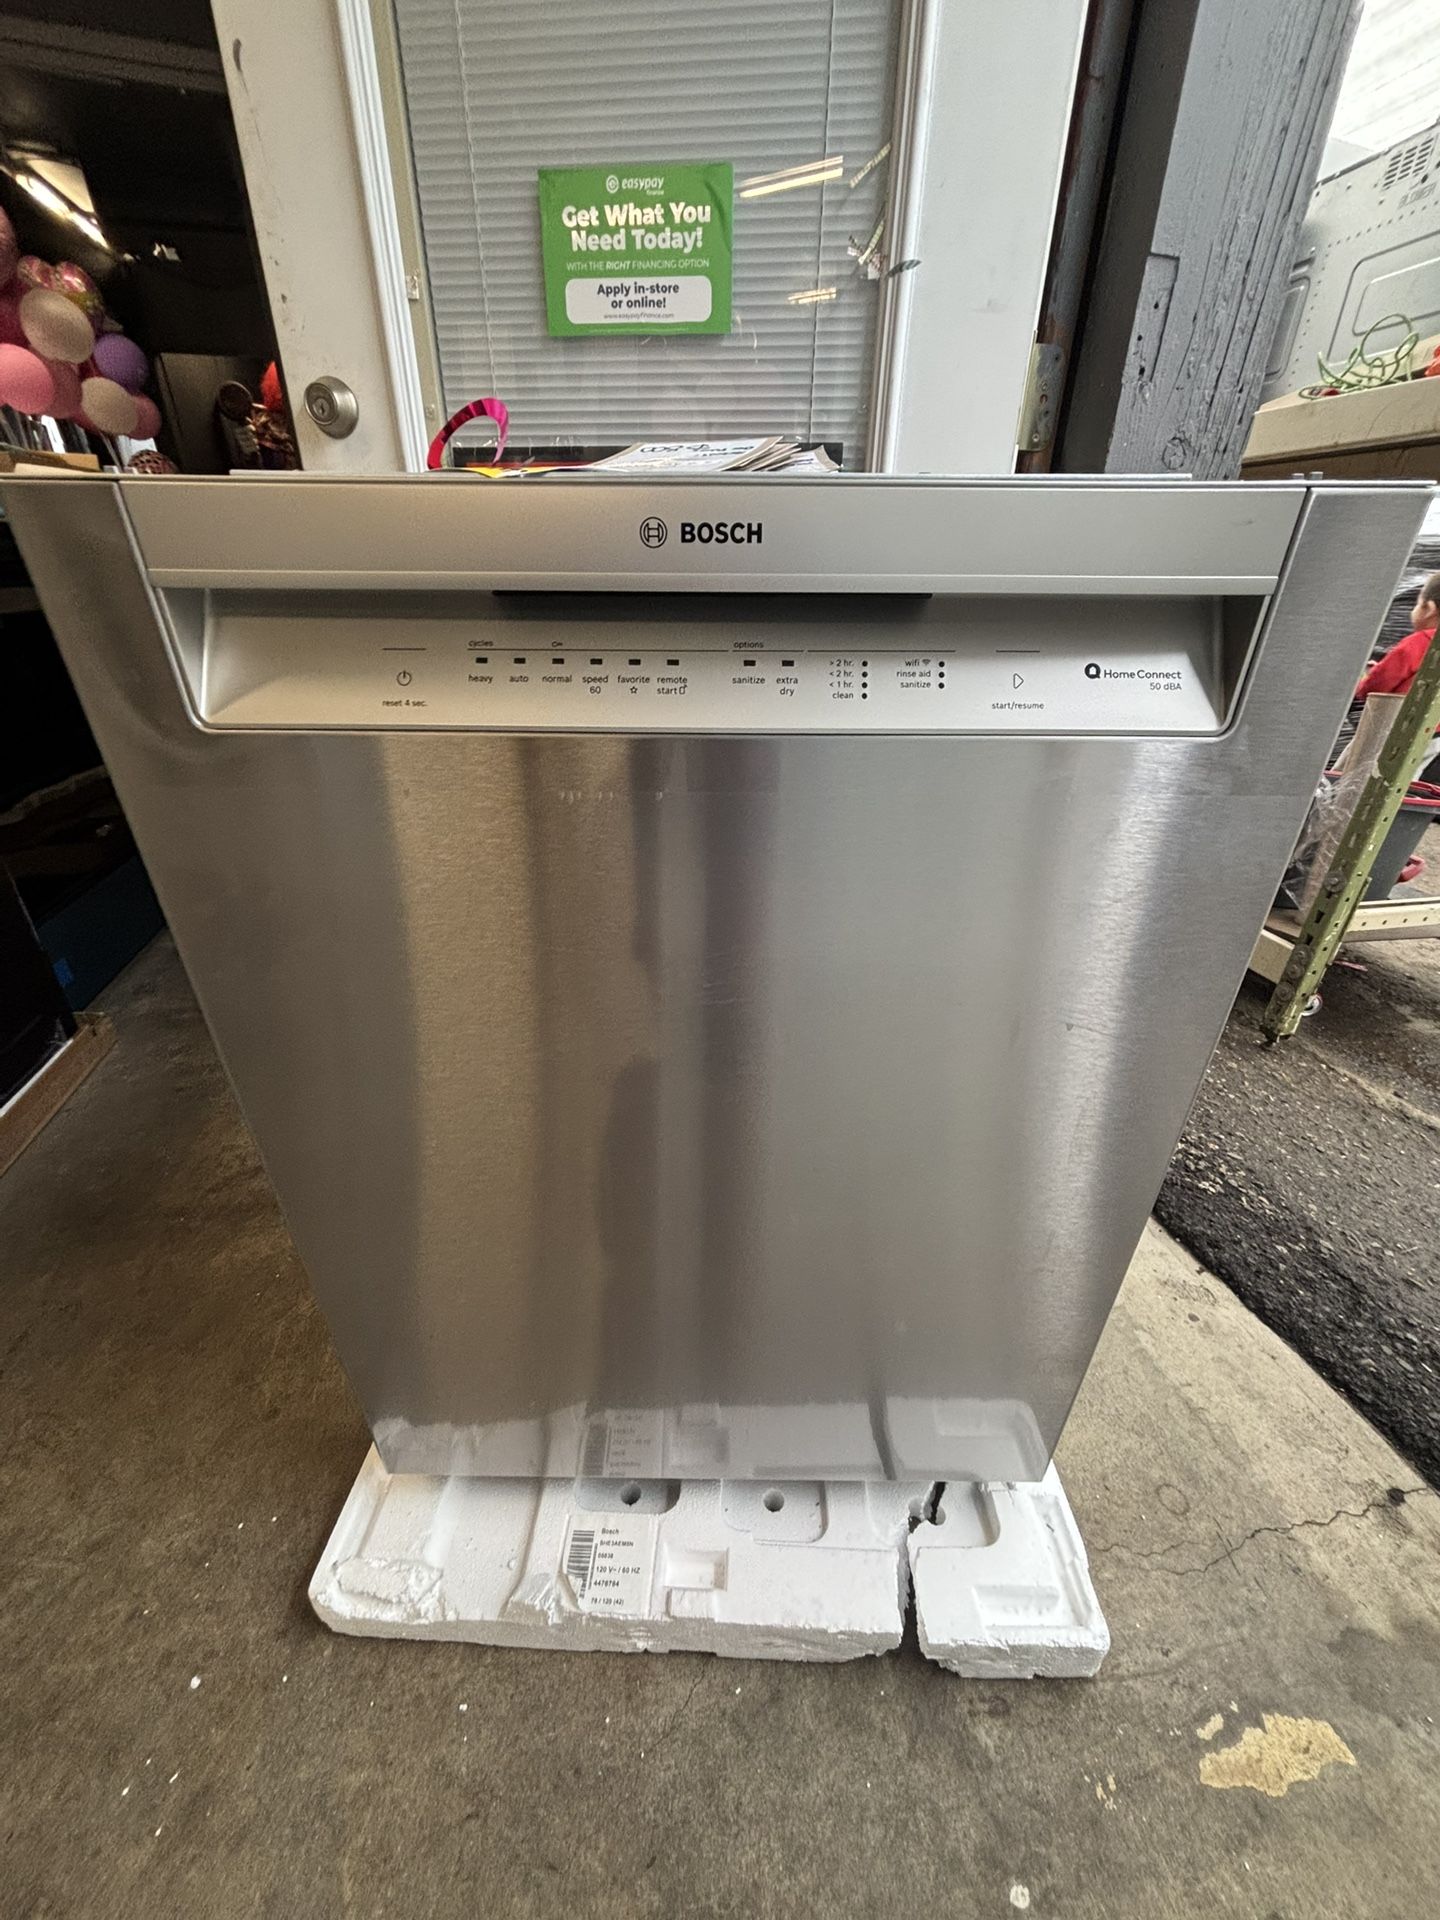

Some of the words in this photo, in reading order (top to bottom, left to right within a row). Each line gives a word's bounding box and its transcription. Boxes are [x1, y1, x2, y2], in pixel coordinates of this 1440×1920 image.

[622, 177, 665, 191] easypay
[562, 205, 599, 228] Get
[604, 202, 665, 227] What
[669, 201, 711, 225] You
[571, 228, 626, 252] Need
[631, 227, 703, 254] Today!
[566, 261, 587, 271] WITH
[589, 261, 604, 271] THE
[606, 260, 631, 271] RIGHT
[632, 259, 677, 270] FINANCING
[678, 258, 710, 269] OPTION
[597, 283, 631, 298] Apply
[634, 281, 679, 294] in-store
[611, 299, 622, 309] or
[626, 296, 666, 309] online!
[681, 522, 763, 544] BOSCH
[468, 639, 494, 647] cycles
[733, 641, 764, 649] options
[836, 659, 842, 667] 2
[843, 659, 854, 667] hr.
[904, 659, 920, 667] wifi
[836, 670, 842, 678] 2
[843, 670, 854, 678] hr.
[896, 670, 917, 678] rinse
[918, 670, 931, 678] aid
[1103, 669, 1136, 679] Home
[1136, 669, 1182, 679] Connect
[468, 674, 493, 684] heavy
[509, 675, 529, 683] auto
[542, 675, 572, 683] normal
[582, 675, 609, 686] speed
[617, 675, 650, 684] favorite
[656, 676, 688, 684] remote
[732, 676, 765, 684] sanitize
[776, 676, 799, 684] extra
[843, 681, 854, 689] hr.
[900, 681, 931, 689] sanitize
[1150, 682, 1161, 690] 50
[1163, 682, 1182, 691] dBA
[589, 686, 601, 694] 60
[656, 686, 677, 695] start
[779, 687, 795, 697] dry
[832, 691, 854, 699] clean
[404, 699, 410, 707] 4
[991, 701, 1044, 710] start/resume
